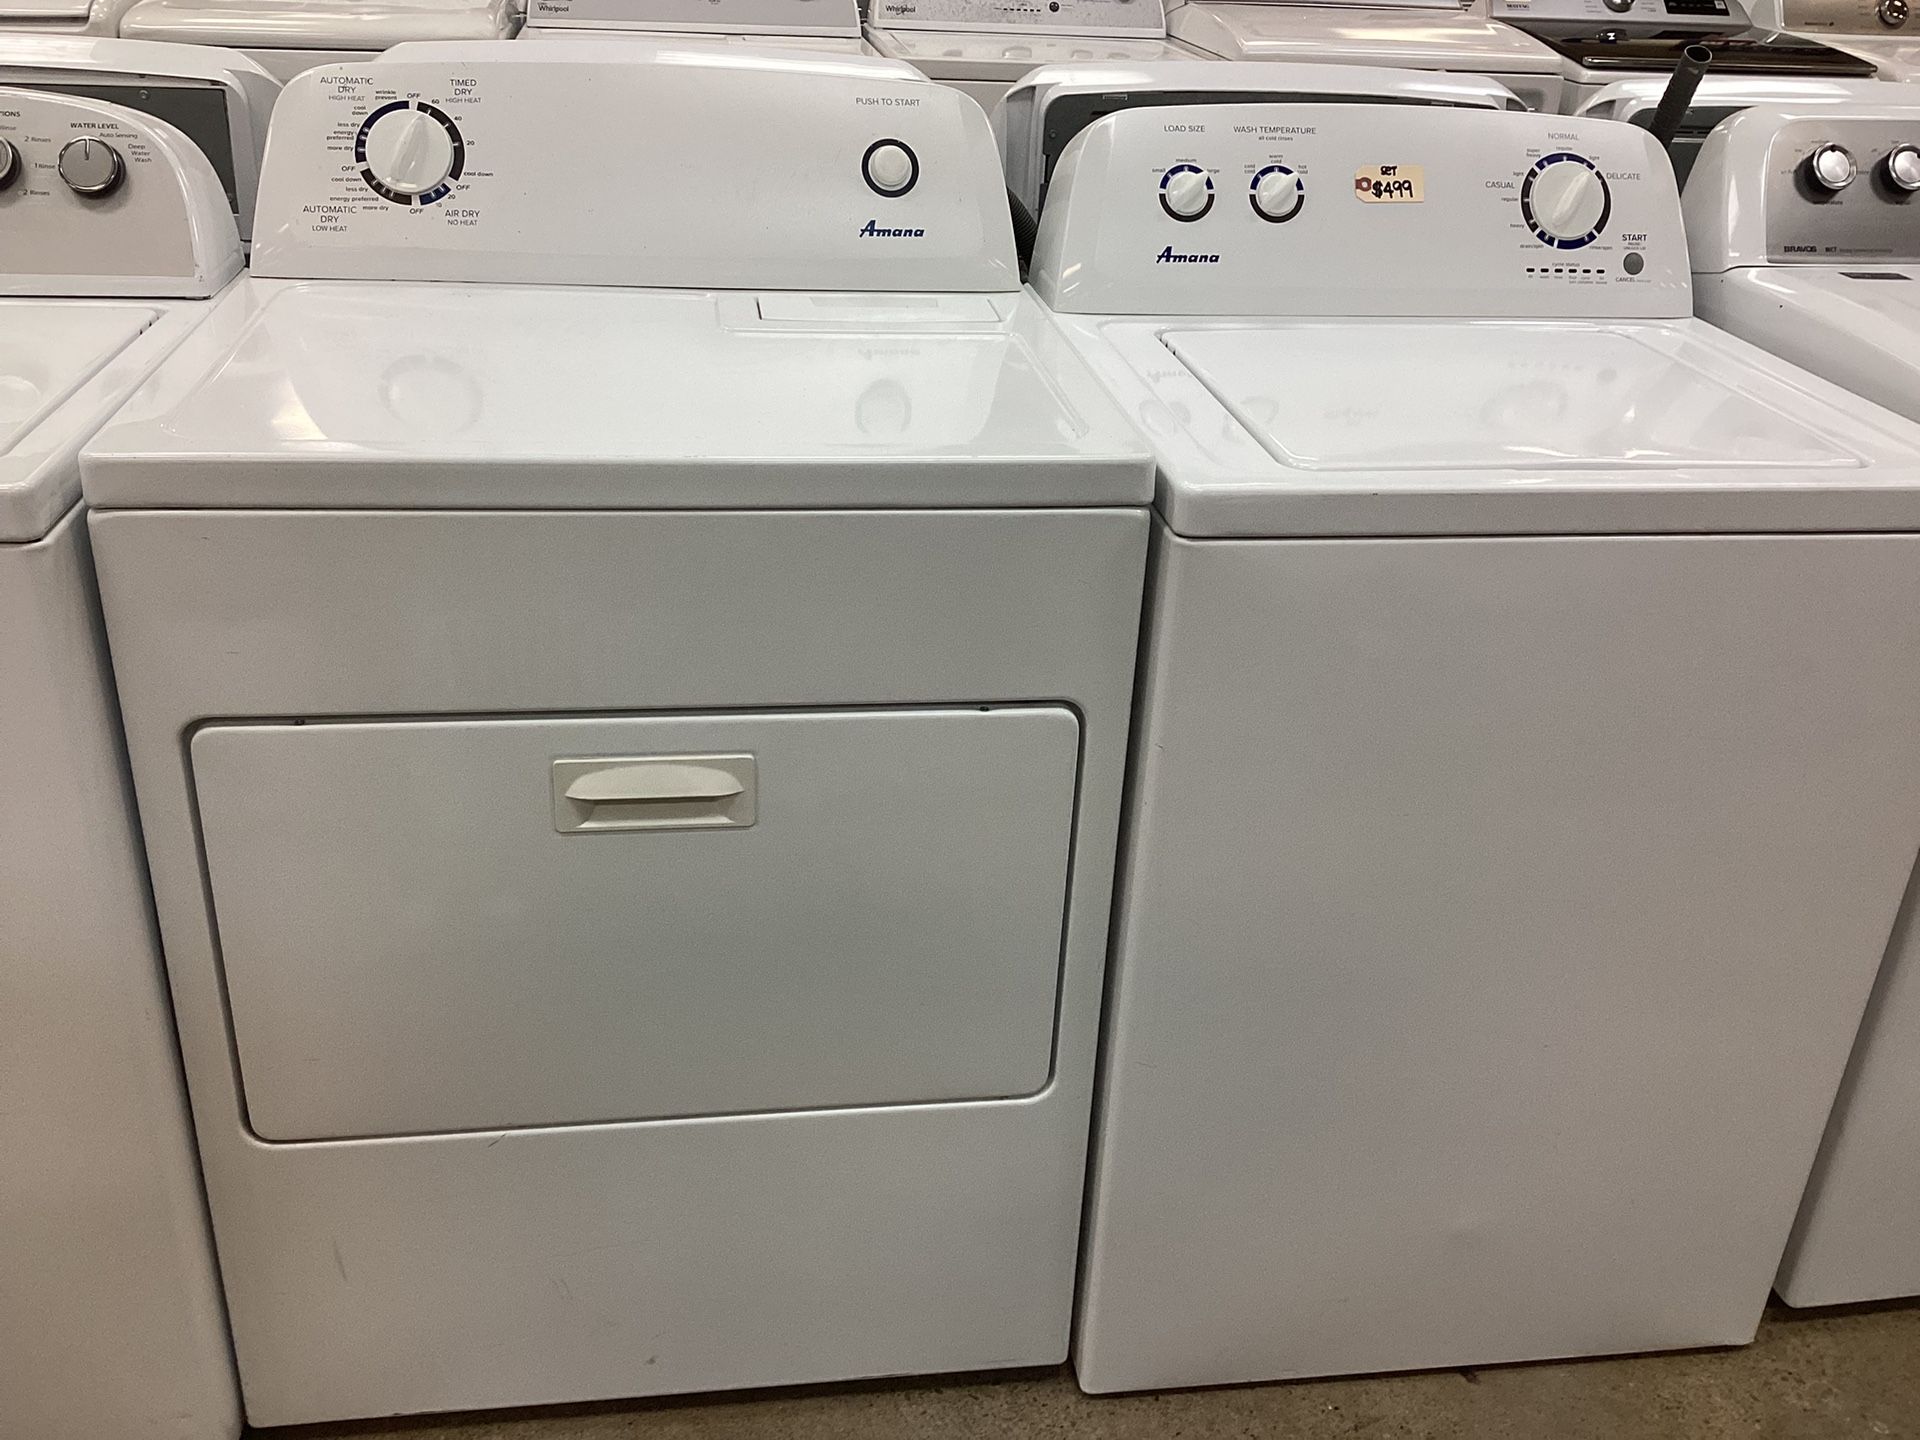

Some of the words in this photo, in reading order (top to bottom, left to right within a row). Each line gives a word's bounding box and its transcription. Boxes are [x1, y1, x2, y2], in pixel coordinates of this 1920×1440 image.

[885, 5, 917, 15] Whirlpool
[320, 77, 374, 85] AUTOMATIC
[450, 79, 477, 87] TIMED
[337, 86, 357, 94] DRY
[454, 88, 473, 96] DRY
[855, 97, 879, 106] PUSH
[881, 98, 893, 106] TO
[894, 98, 921, 107] START
[71, 122, 96, 130] WATER
[1163, 125, 1187, 133] LOAD
[1188, 125, 1206, 133] SIZE
[1233, 126, 1258, 134] WASH
[1259, 126, 1317, 135] TEMPERATURE
[115, 132, 139, 140] Sensing
[1547, 132, 1580, 141] NORMAL
[128, 143, 146, 151] Deep
[1606, 172, 1641, 181] DELICATE
[1371, 179, 1414, 199] $499
[1485, 180, 1515, 189] CASUAL
[302, 205, 357, 214] AUTOMATIC
[445, 209, 460, 218] AIR
[461, 210, 481, 218] DRY
[320, 215, 340, 223] DRY
[859, 219, 925, 238] Amana
[1621, 233, 1648, 242] START
[1783, 245, 1818, 253] BRAVOS
[1156, 245, 1220, 264] Amana
